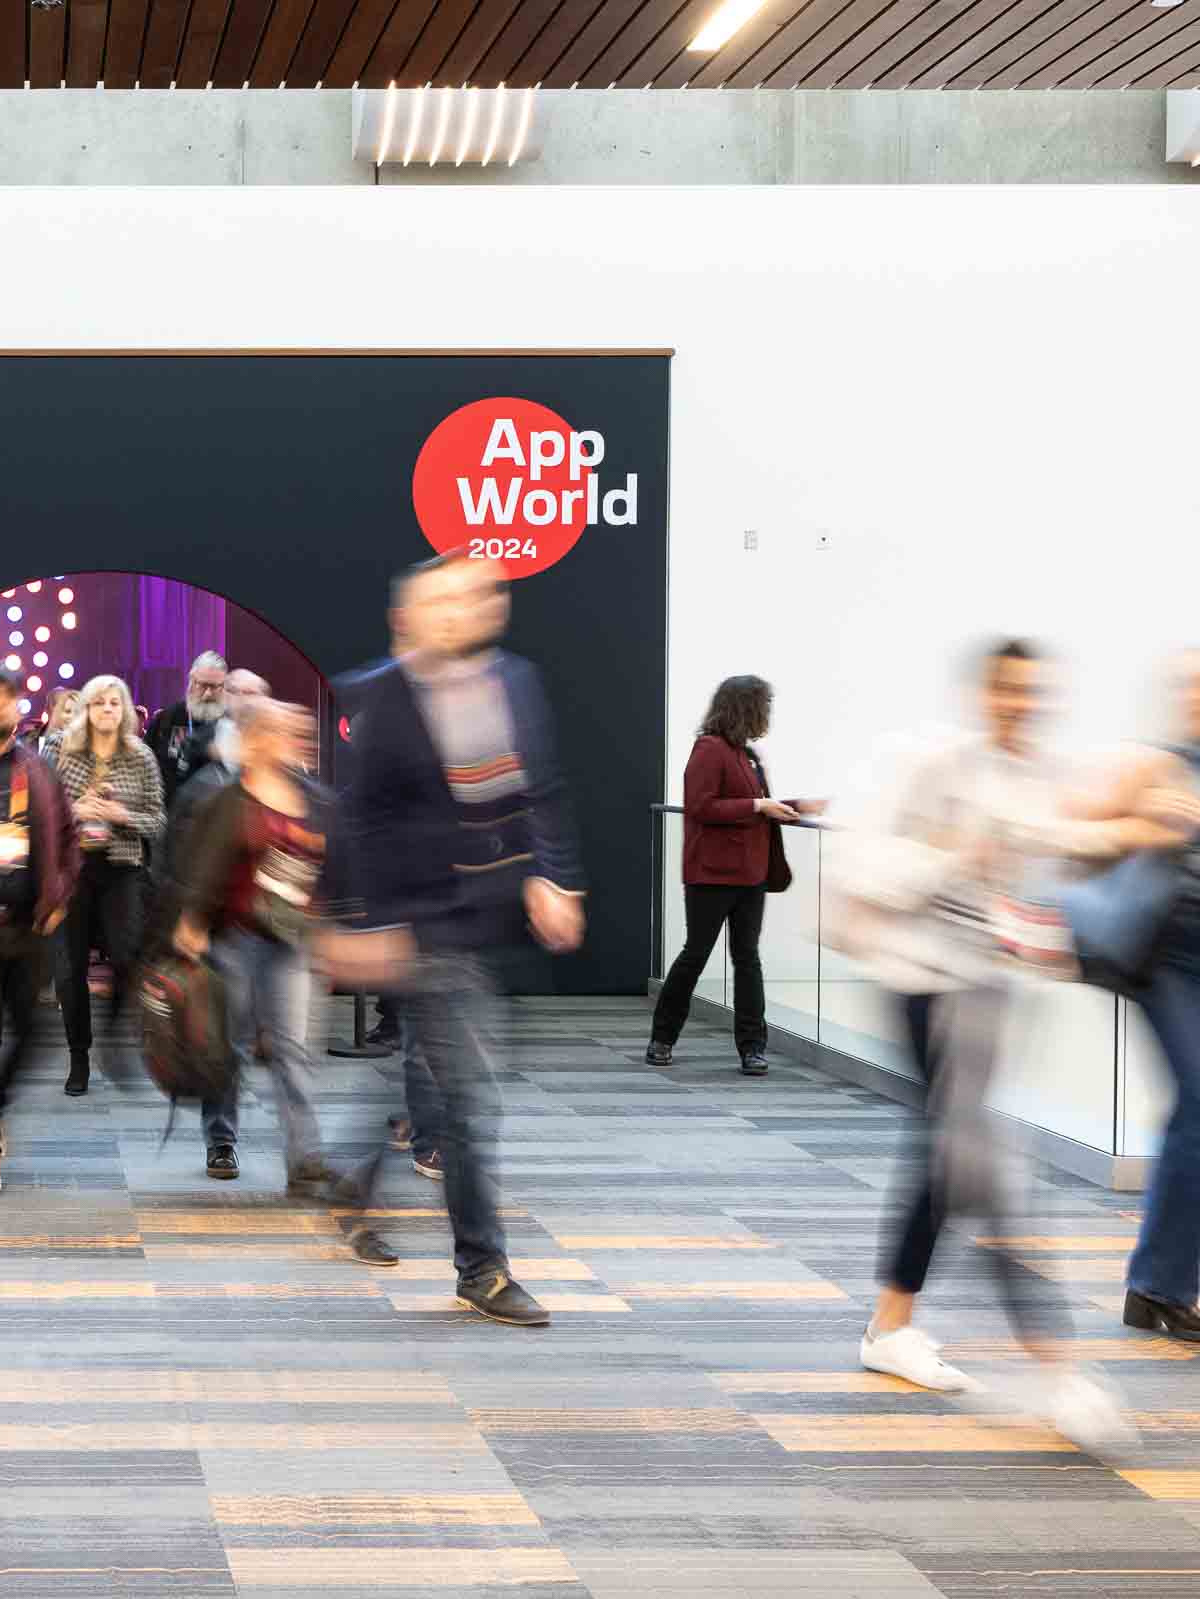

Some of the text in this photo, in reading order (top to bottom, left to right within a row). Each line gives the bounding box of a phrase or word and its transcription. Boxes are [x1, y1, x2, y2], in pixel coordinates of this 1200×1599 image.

[480, 418, 605, 481] App
[456, 473, 638, 526] World
[468, 538, 537, 559] 2024
